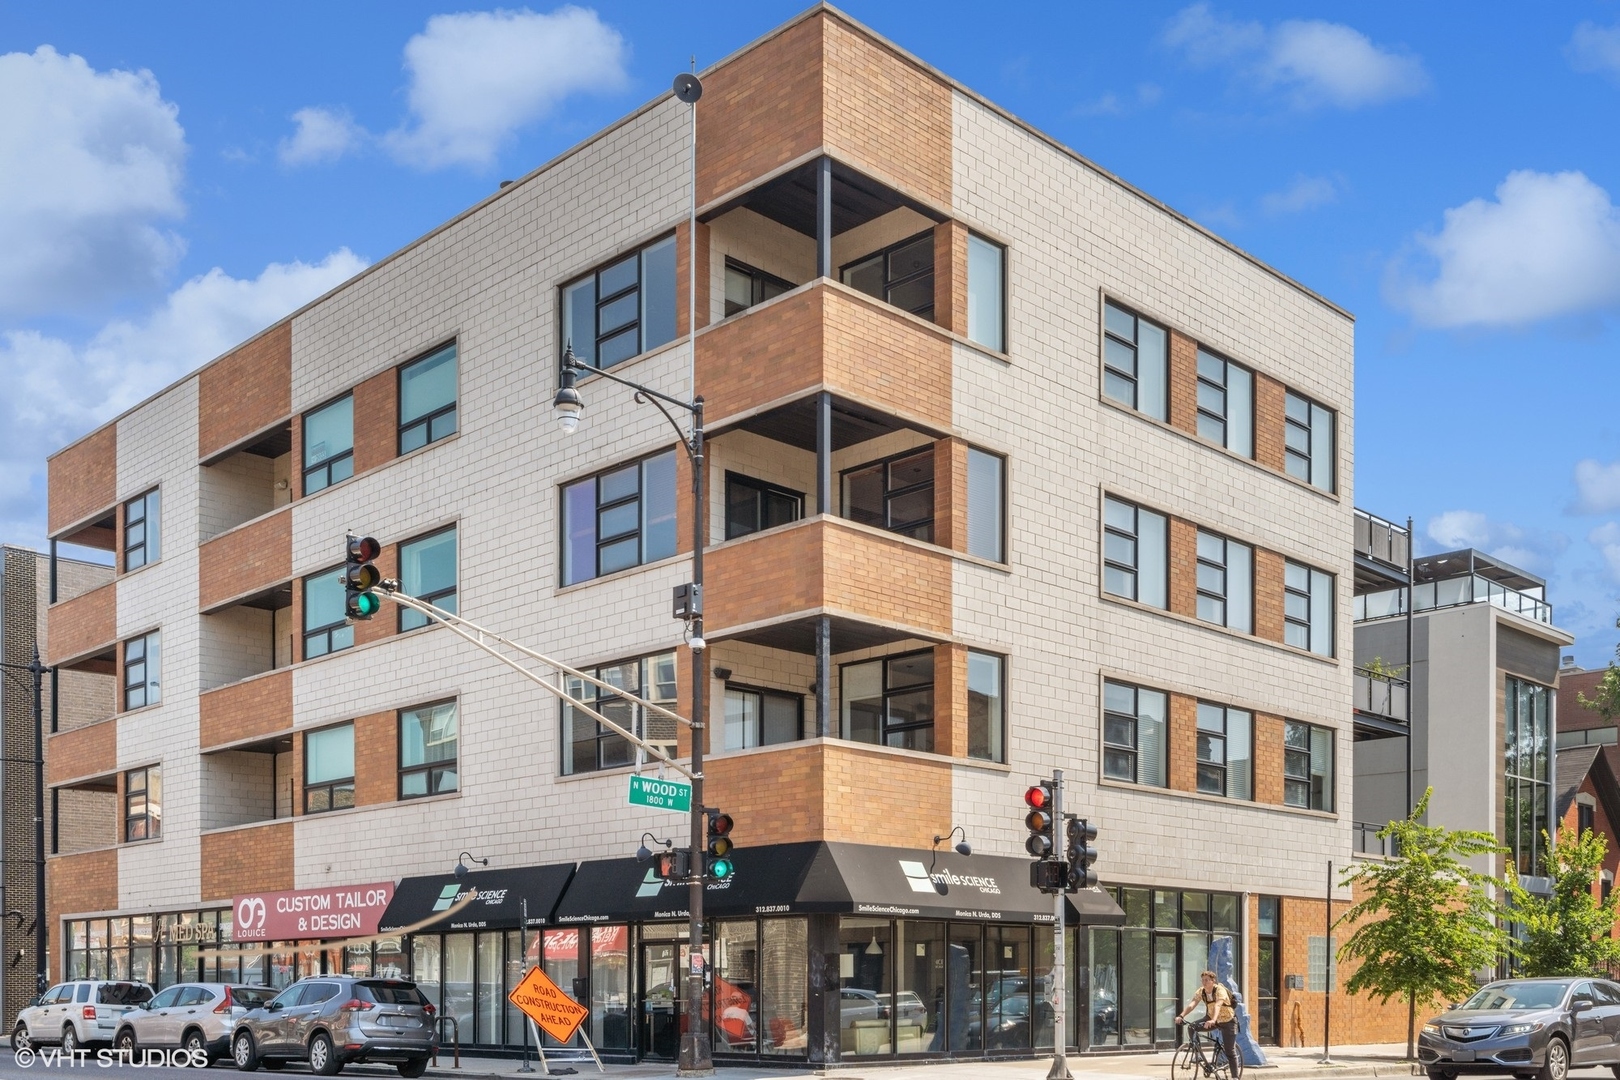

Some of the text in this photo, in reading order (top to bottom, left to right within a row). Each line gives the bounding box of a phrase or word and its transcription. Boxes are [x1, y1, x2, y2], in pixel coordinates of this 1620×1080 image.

[633, 780, 688, 796] N WOOD ST
[646, 795, 674, 806] 1800 W
[930, 868, 998, 888] smile SCIENCE
[706, 882, 730, 890] CHICAGO
[276, 889, 387, 913] CUSTOM TAILOR
[476, 889, 508, 900] SCIENCE
[755, 904, 790, 913] 312.837.0010
[858, 904, 920, 915] SmileScienceChicago.com
[298, 913, 361, 932] & DESIGN
[558, 914, 609, 922] SmileScienceChicago.com
[169, 924, 194, 942] MED
[196, 922, 216, 940] SPA
[237, 928, 266, 938] LOUICE
[532, 984, 556, 998] ROAD
[516, 994, 582, 1014] CONSTRUCTION
[540, 1012, 572, 1026] AHEAD
